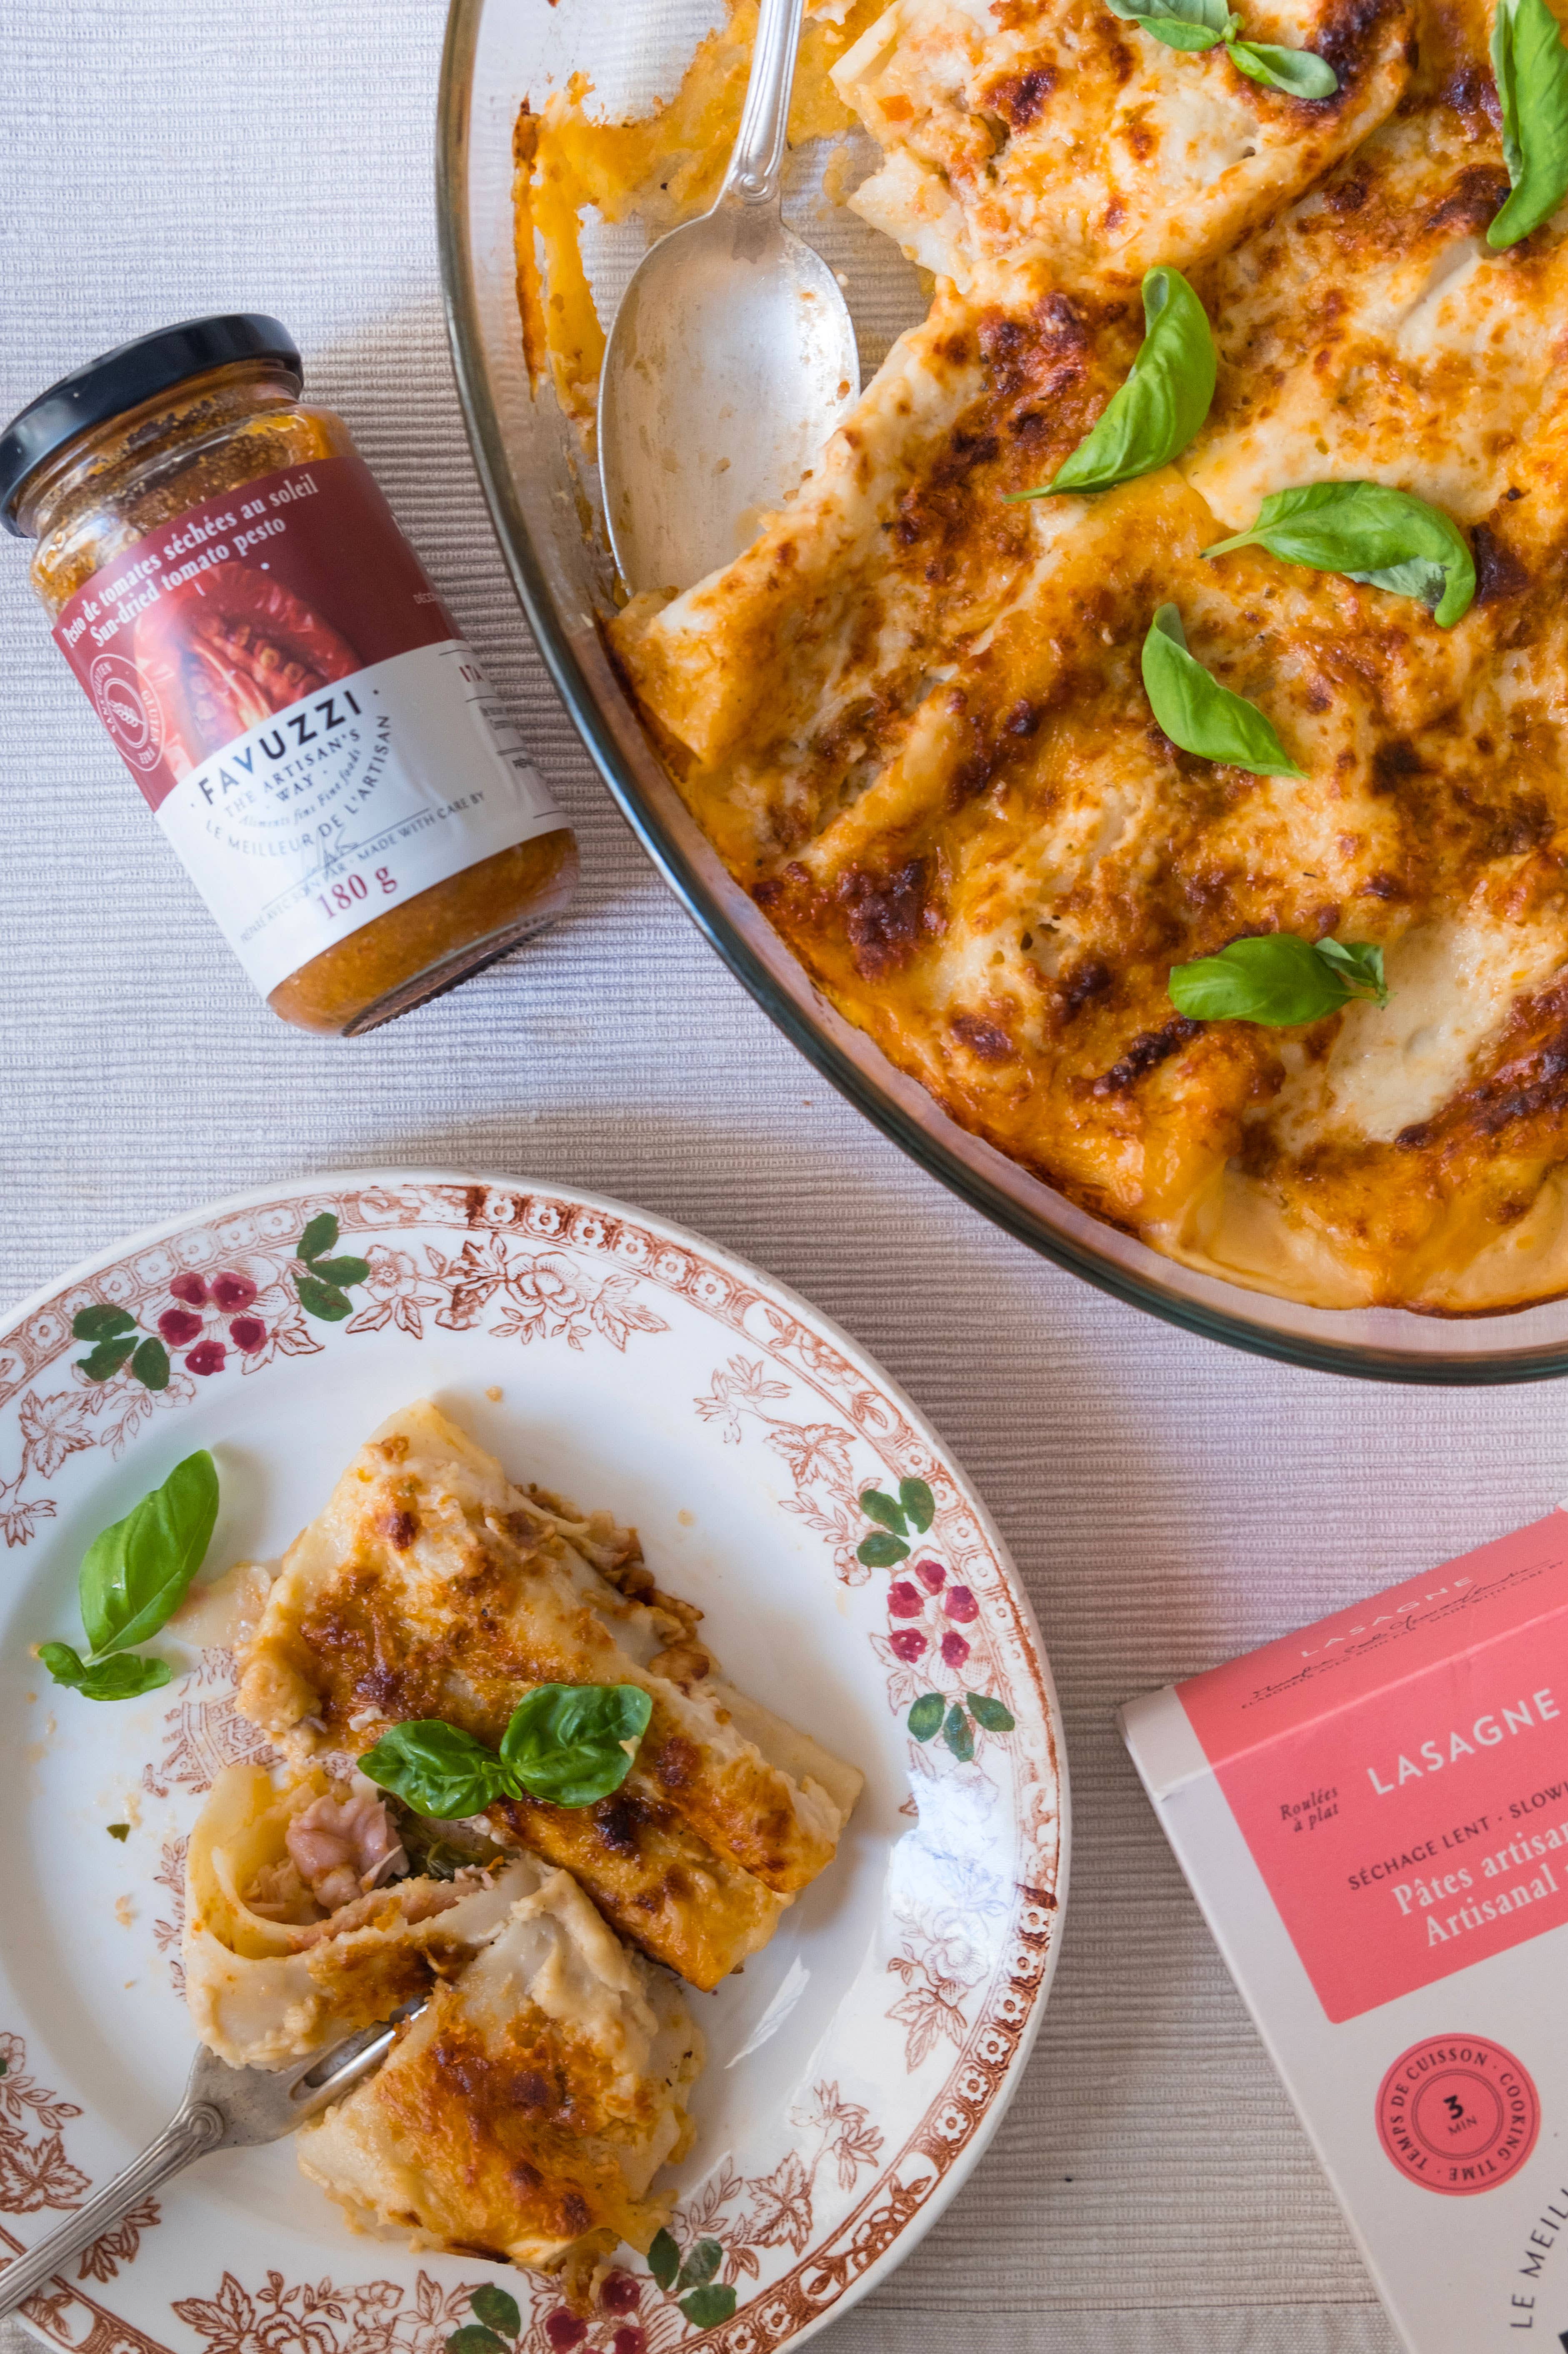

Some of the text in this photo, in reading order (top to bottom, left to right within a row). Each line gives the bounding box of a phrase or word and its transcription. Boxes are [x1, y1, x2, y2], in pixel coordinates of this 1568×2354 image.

[62, 473, 319, 648] Pesto de tomates séchées au soleil
[90, 518, 286, 647] Sun-dried tomato pesto
[198, 689, 362, 806] FAVUZZI
[224, 728, 361, 818] THE ARTISAN'S
[205, 819, 222, 840] LE
[228, 833, 315, 857] MEILLEUR
[318, 814, 345, 839] DE
[343, 714, 392, 815] L'ARTISAN
[276, 773, 315, 802] WAY
[357, 834, 397, 860] MADE
[397, 814, 437, 837] WITH
[437, 797, 470, 820] CARE
[469, 791, 485, 804] BY
[317, 866, 398, 919] 180 g
[1300, 1576, 1473, 1658] LASAGNE
[1429, 1605, 1466, 1623] MADE
[1471, 1586, 1507, 1604] WITH
[1511, 1570, 1543, 1587] CARE
[1366, 1687, 1561, 1796] LASAGNE
[1280, 1786, 1340, 1821] Roulées
[1308, 1802, 1340, 1831] plat
[1347, 1840, 1438, 1891] SÉCHAGE
[1441, 1816, 1492, 1850] LENT
[1390, 1867, 1474, 1917] Pâtes
[1426, 1861, 1560, 1948] Artisanal
[1390, 2047, 1488, 2171] TEMPS DE CUISSON
[1443, 2094, 1464, 2121] 3
[1448, 2115, 1478, 2136] MIN
[1449, 2072, 1526, 2181] COOKING TIME
[1510, 2293, 1535, 2329] LE
